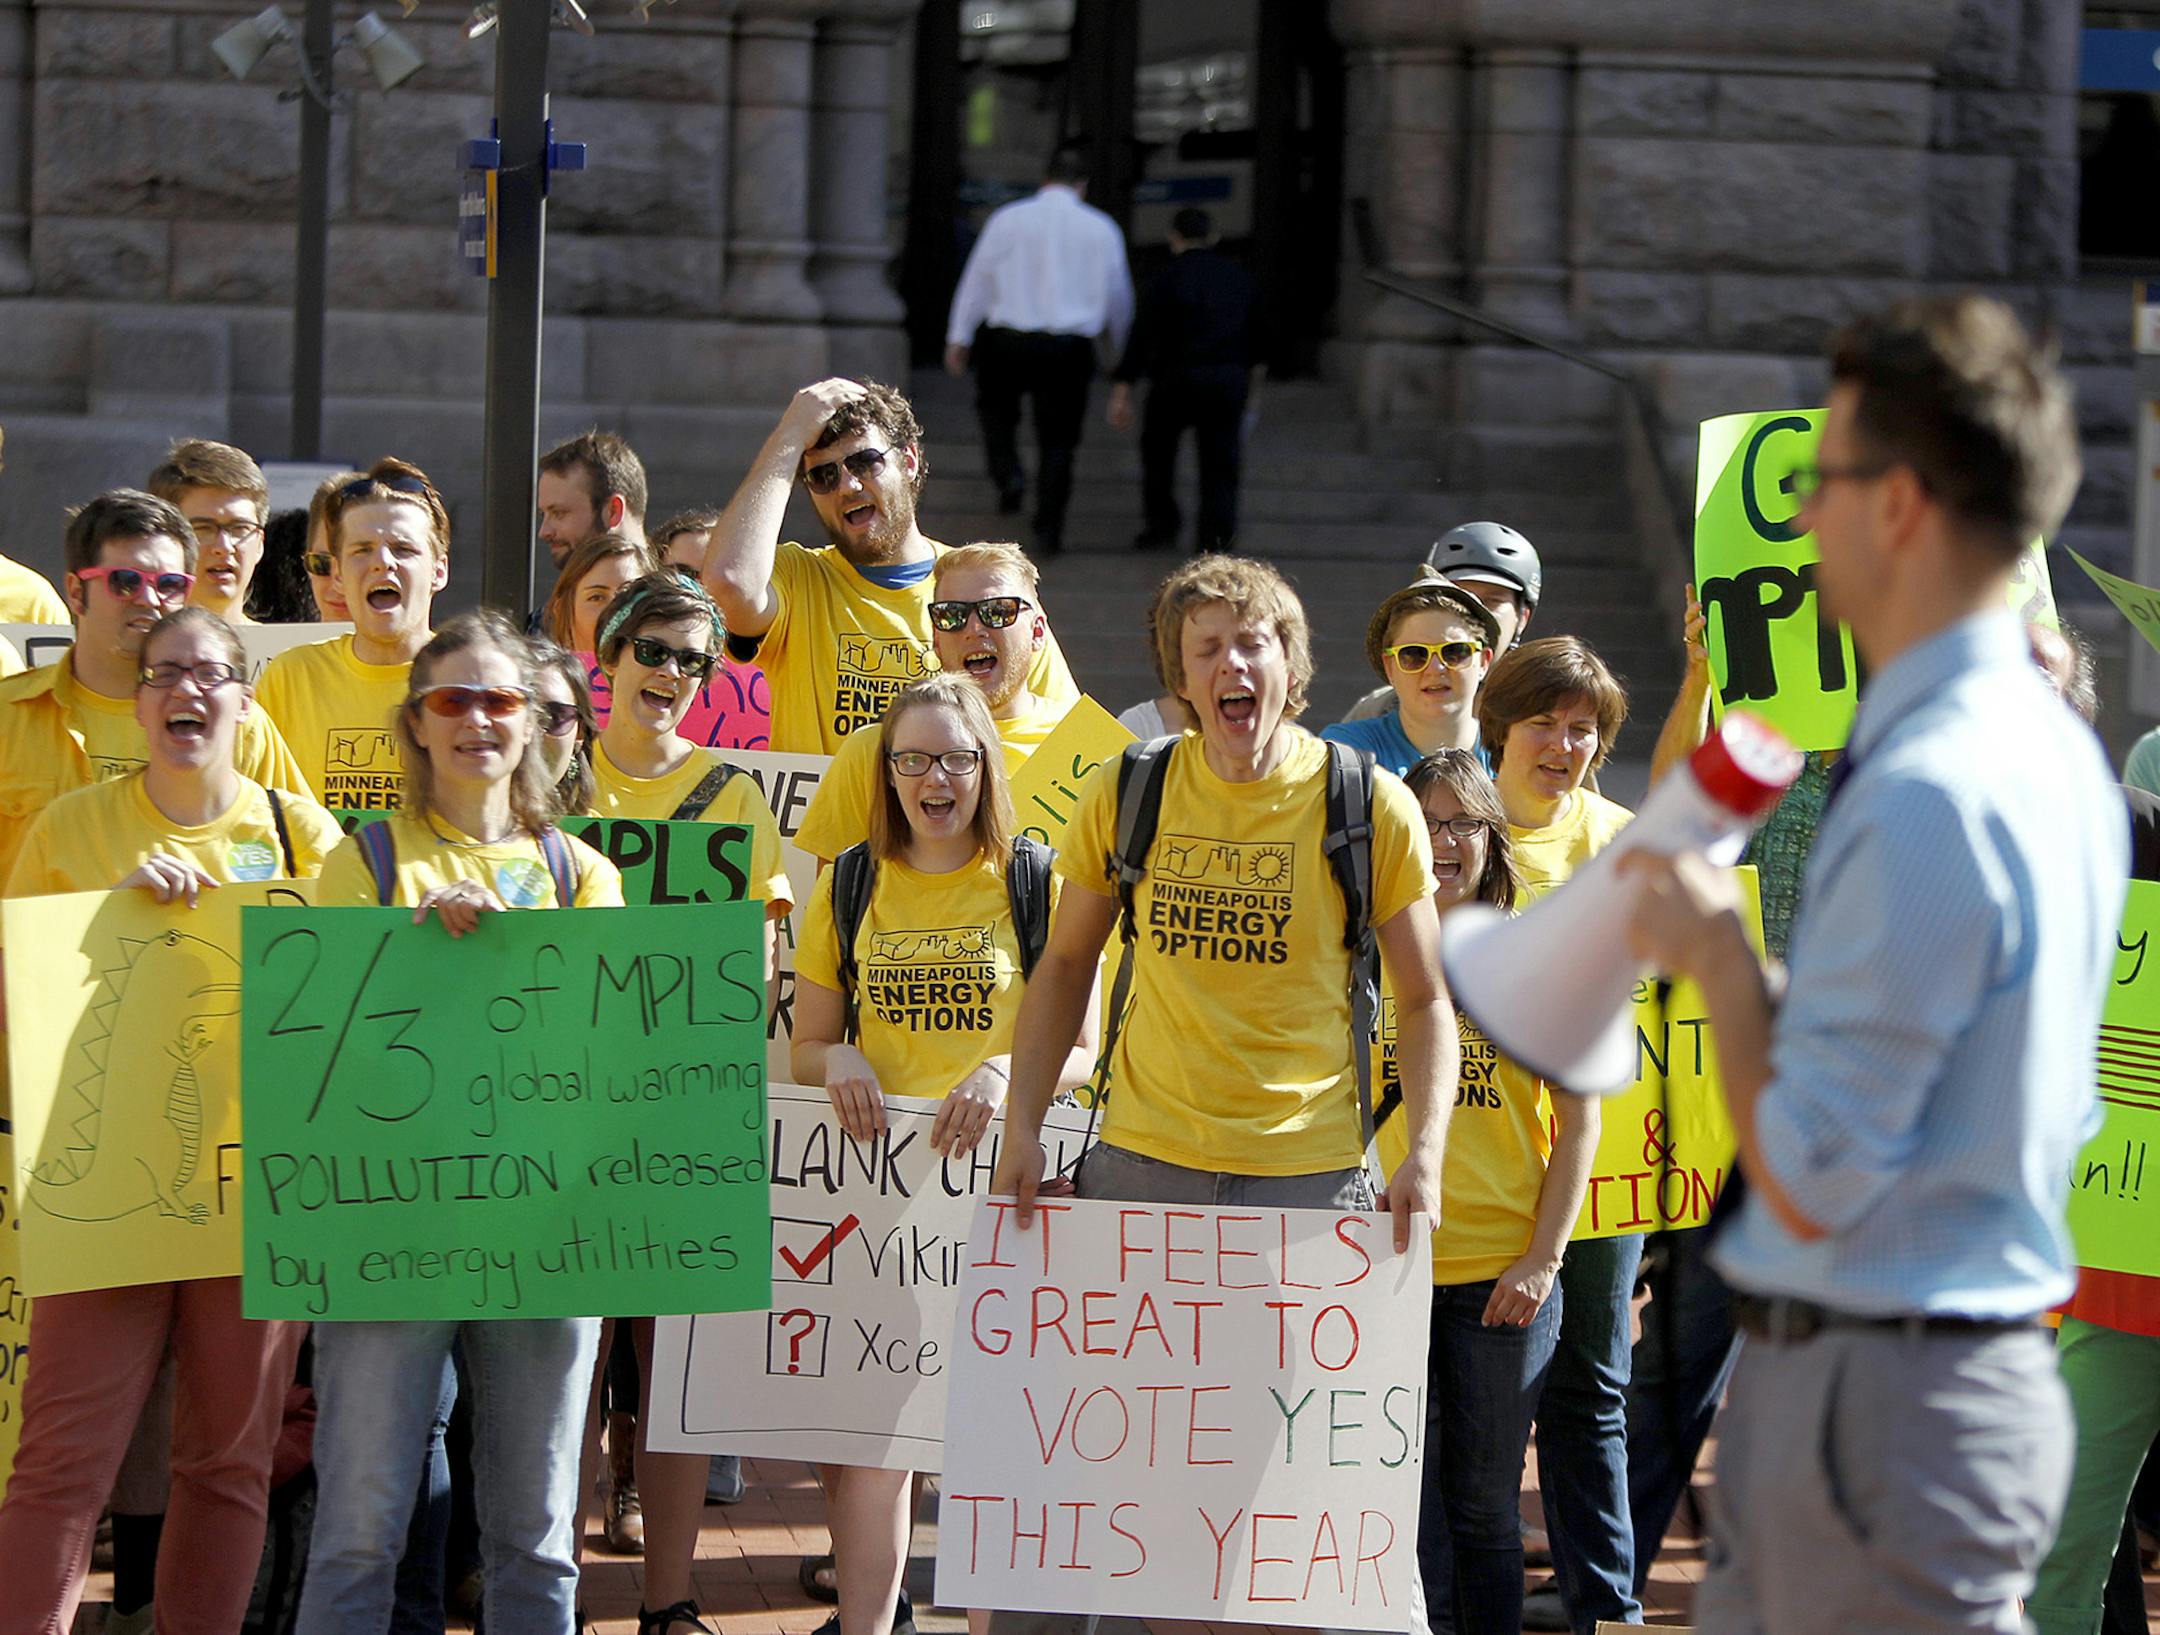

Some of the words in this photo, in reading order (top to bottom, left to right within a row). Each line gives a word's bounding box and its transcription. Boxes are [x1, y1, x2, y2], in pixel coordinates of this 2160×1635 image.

[834, 690, 893, 714] ENE
[1149, 900, 1293, 938] ENERGY
[1152, 882, 1293, 911] MINNEAPOLIS
[867, 966, 996, 983] MINNEAPOLIS
[1151, 929, 1289, 963] OPTIONS
[261, 928, 436, 1124] 2/3
[487, 944, 566, 1033] of
[591, 950, 762, 1037] MPLS
[867, 983, 996, 1006] ENERGY
[876, 1007, 994, 1032] OPTIONS
[468, 1043, 592, 1138] global
[607, 1062, 764, 1131] warming
[259, 1150, 558, 1216] POLLUTION
[586, 1137, 767, 1188] released
[769, 1118, 919, 1199] LANK
[1643, 1107, 1678, 1167] &
[266, 1241, 330, 1316] by
[358, 1246, 522, 1309] energy
[536, 1215, 740, 1275] utilities
[970, 1201, 1072, 1278] IT
[1119, 1208, 1374, 1291] FEELS
[970, 1287, 1224, 1366] GREAT
[1265, 1302, 1361, 1373] TO
[1023, 1385, 1234, 1467] VOTE
[1267, 1384, 1425, 1470] YES!
[950, 1495, 1147, 1578] THIS
[1198, 1508, 1395, 1608] YEAR
